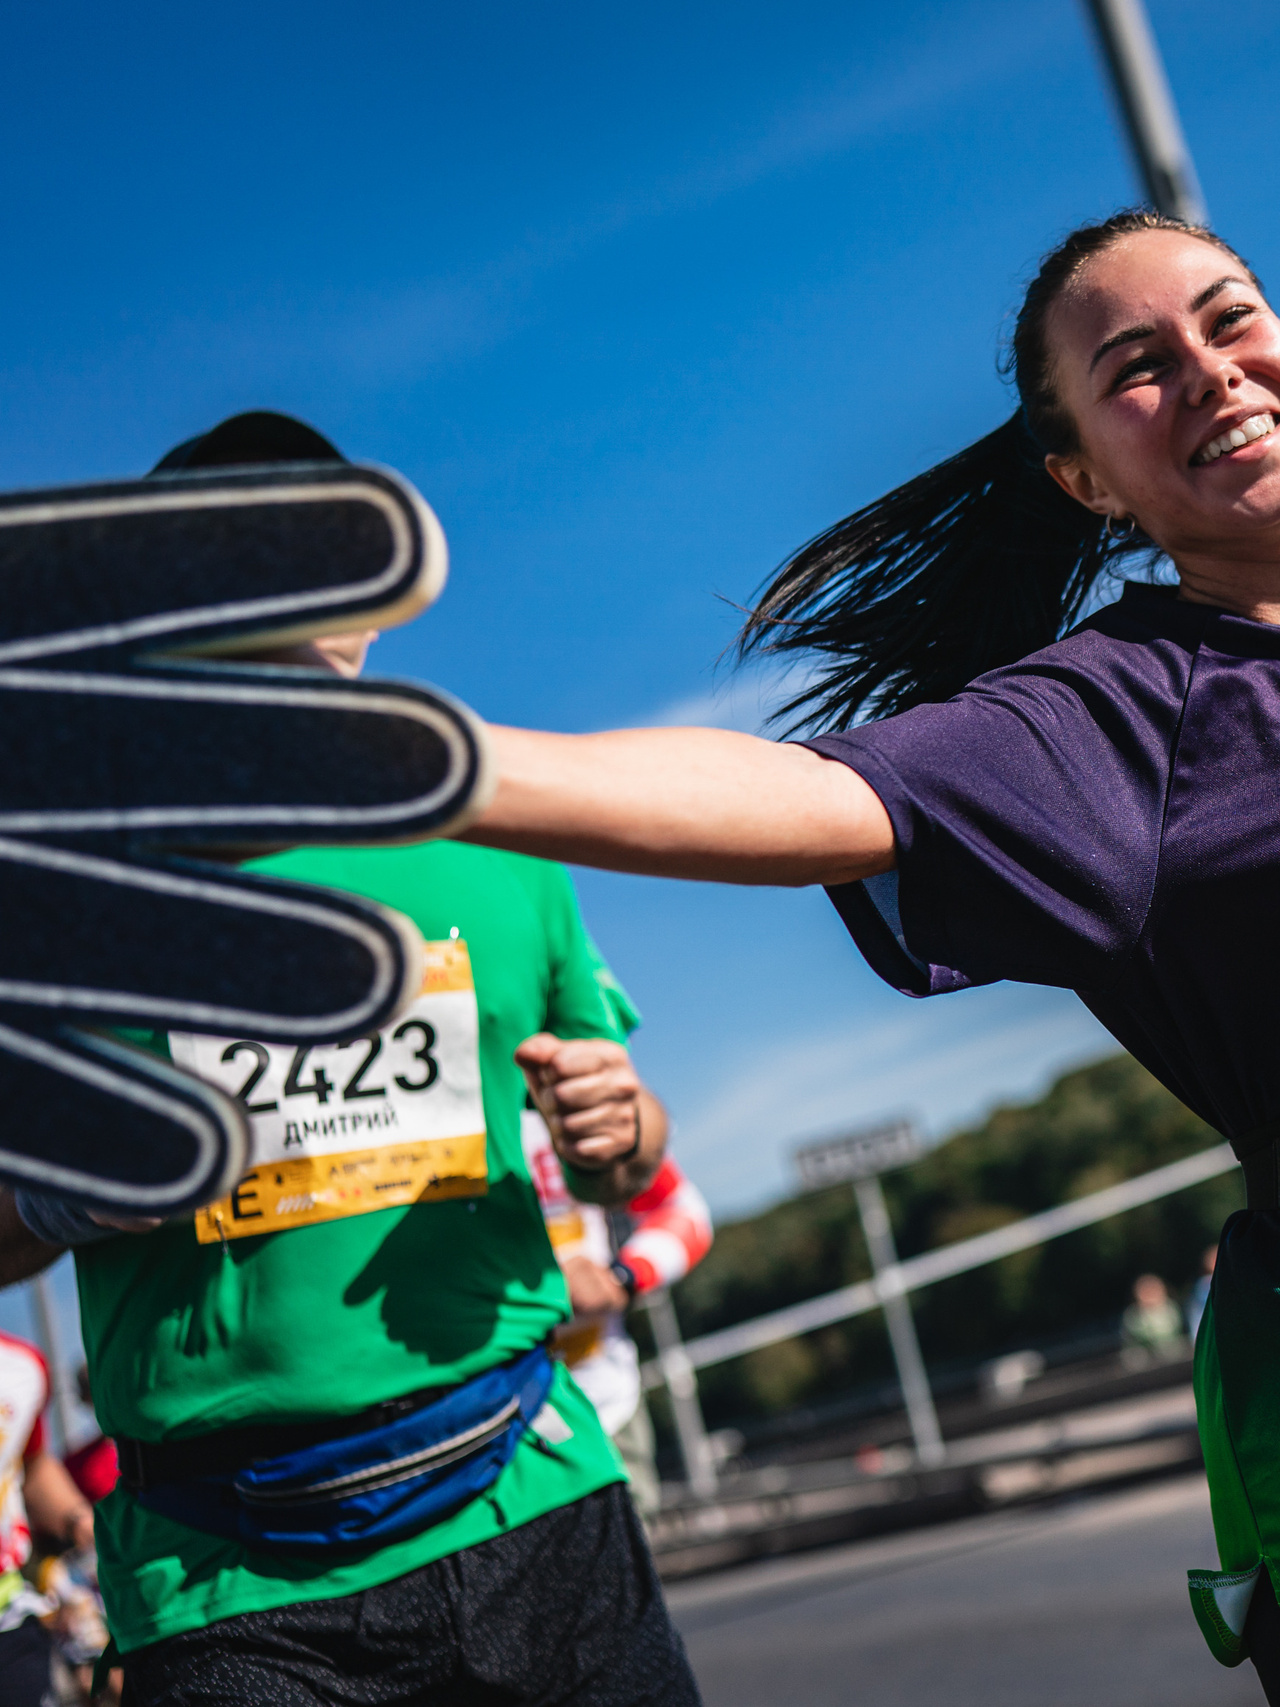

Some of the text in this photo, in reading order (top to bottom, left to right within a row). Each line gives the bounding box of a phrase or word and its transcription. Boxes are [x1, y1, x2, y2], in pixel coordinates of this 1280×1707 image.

[221, 1020, 439, 1115] 2423
[284, 1102, 398, 1148] ДМИТРИЙ
[231, 1173, 263, 1219] E
